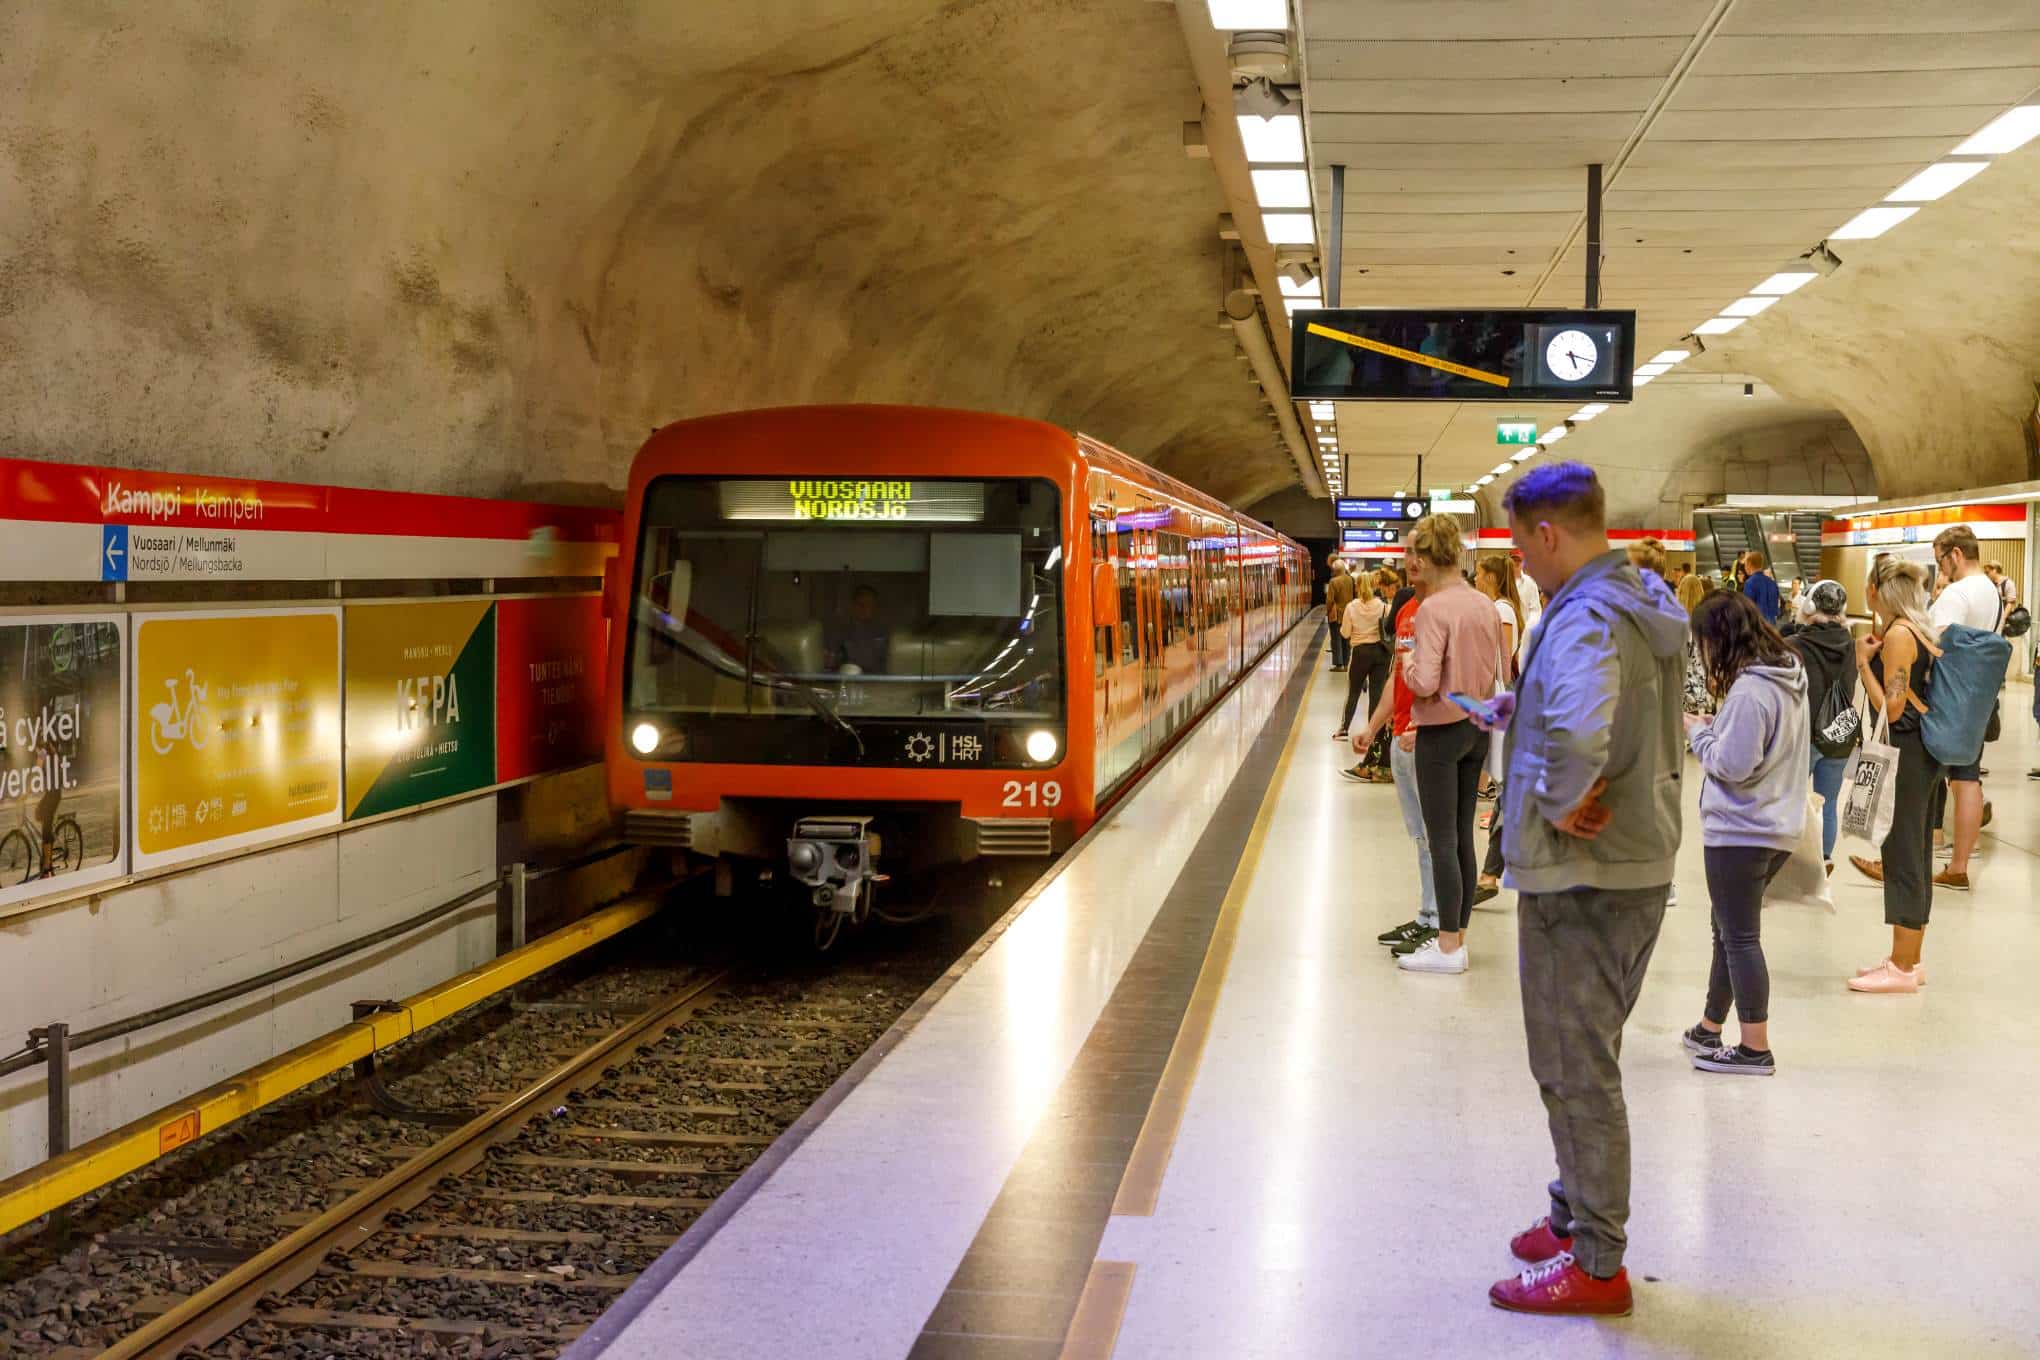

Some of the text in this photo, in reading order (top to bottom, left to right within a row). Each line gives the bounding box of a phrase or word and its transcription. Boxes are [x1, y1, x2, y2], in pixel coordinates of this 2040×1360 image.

[1605, 331, 1612, 343] 1
[790, 481, 912, 499] VUOSAARI
[108, 481, 263, 525] Kamppi Kampen
[794, 499, 907, 519] NORDSJÖ
[133, 535, 176, 551] Vuosaari
[186, 537, 236, 553] Mellunmäki
[132, 556, 170, 574] Nordsjö
[180, 557, 243, 574] Mellungsbacka
[15, 703, 80, 752] cykel
[952, 735, 983, 748] HSL
[952, 748, 983, 760] HRT
[1002, 780, 1062, 808] 219
